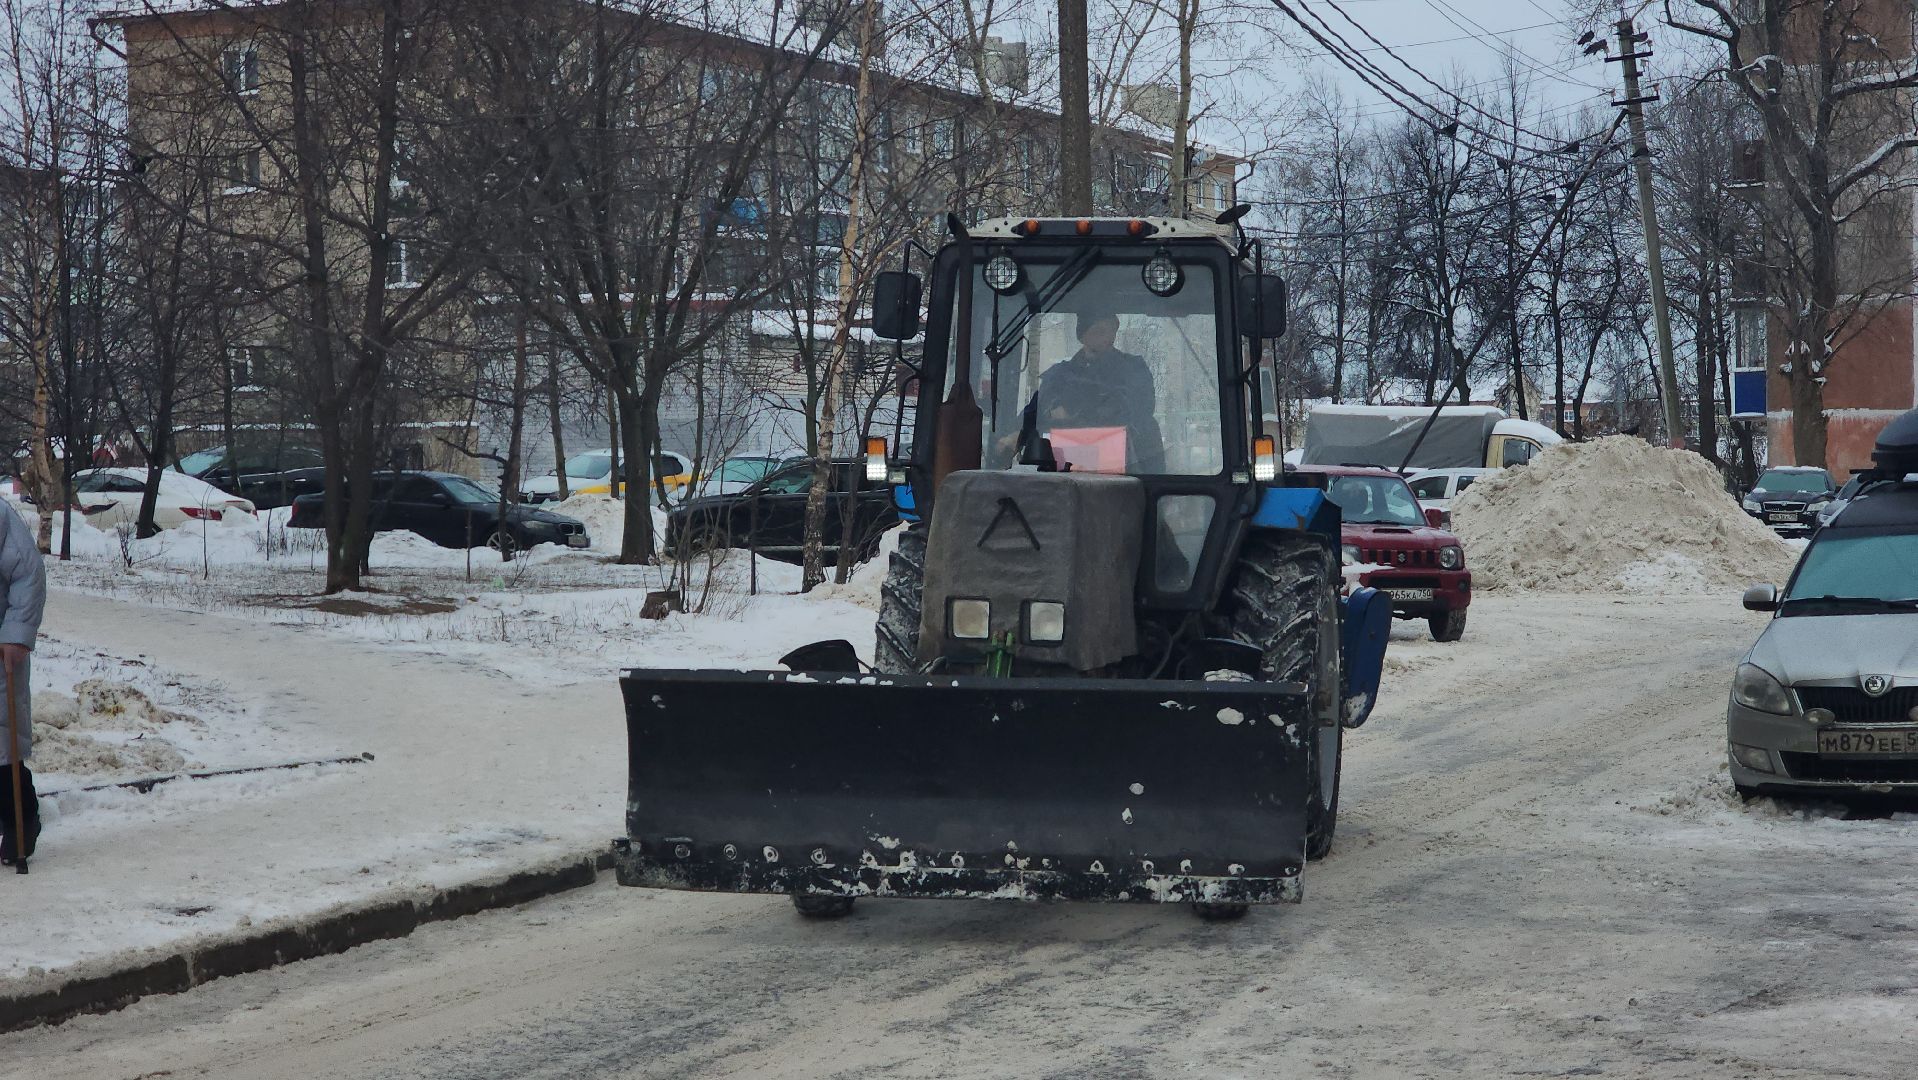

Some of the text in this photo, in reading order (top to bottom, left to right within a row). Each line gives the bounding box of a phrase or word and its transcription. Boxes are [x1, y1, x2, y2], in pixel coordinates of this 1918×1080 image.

[1390, 590, 1417, 600] 965КА
[1825, 732, 1918, 752] М879ЕЕ 5
